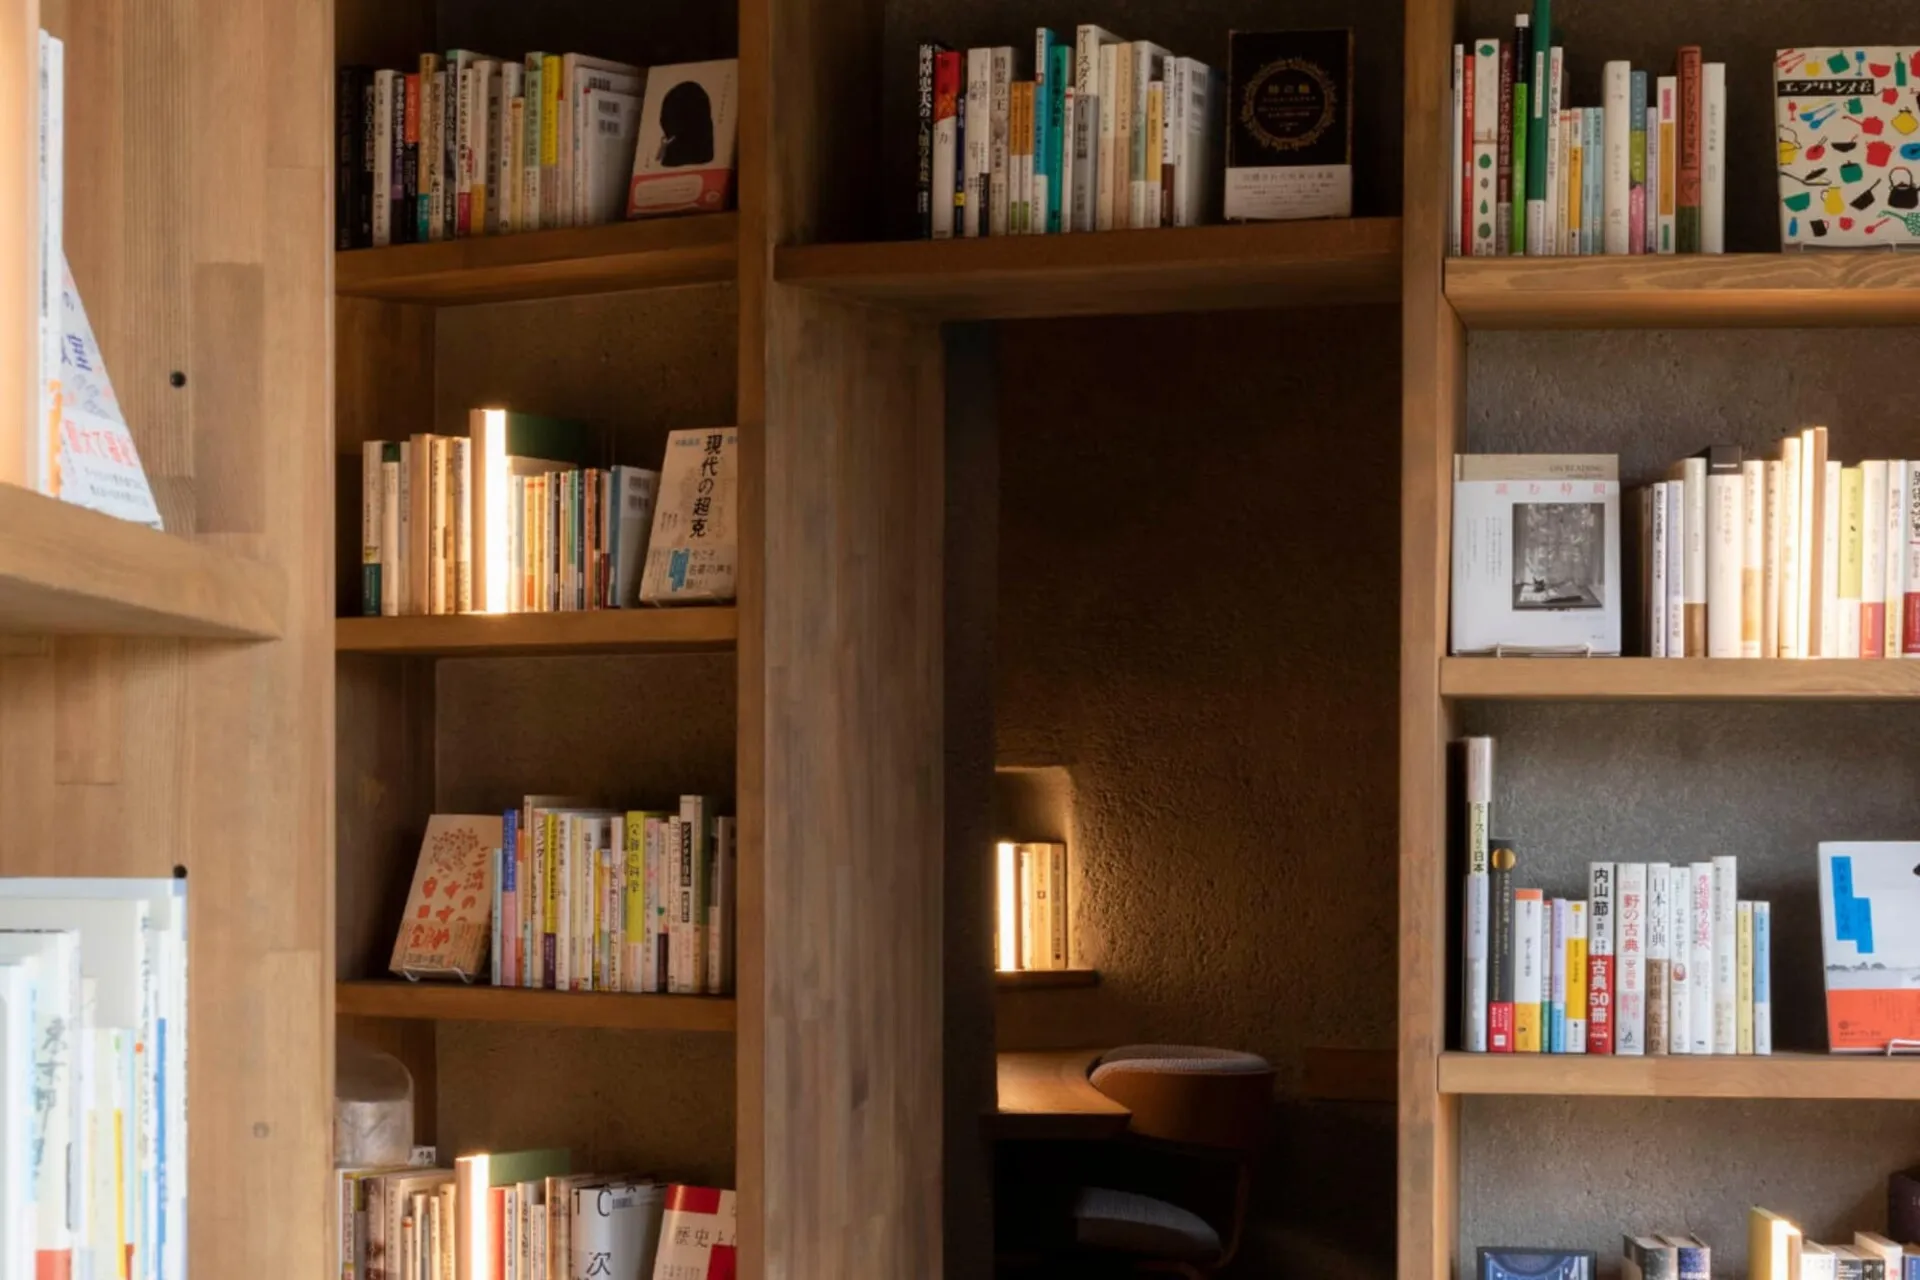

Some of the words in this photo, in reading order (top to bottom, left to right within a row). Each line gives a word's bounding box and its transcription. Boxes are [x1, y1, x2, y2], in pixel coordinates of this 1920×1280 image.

[1782, 81, 1872, 94] エプロンメモ
[689, 434, 724, 538] 現代の超克
[1592, 867, 1610, 917] 内山節
[1622, 893, 1641, 953] 野の古典
[1590, 959, 1609, 1023] 古典50冊
